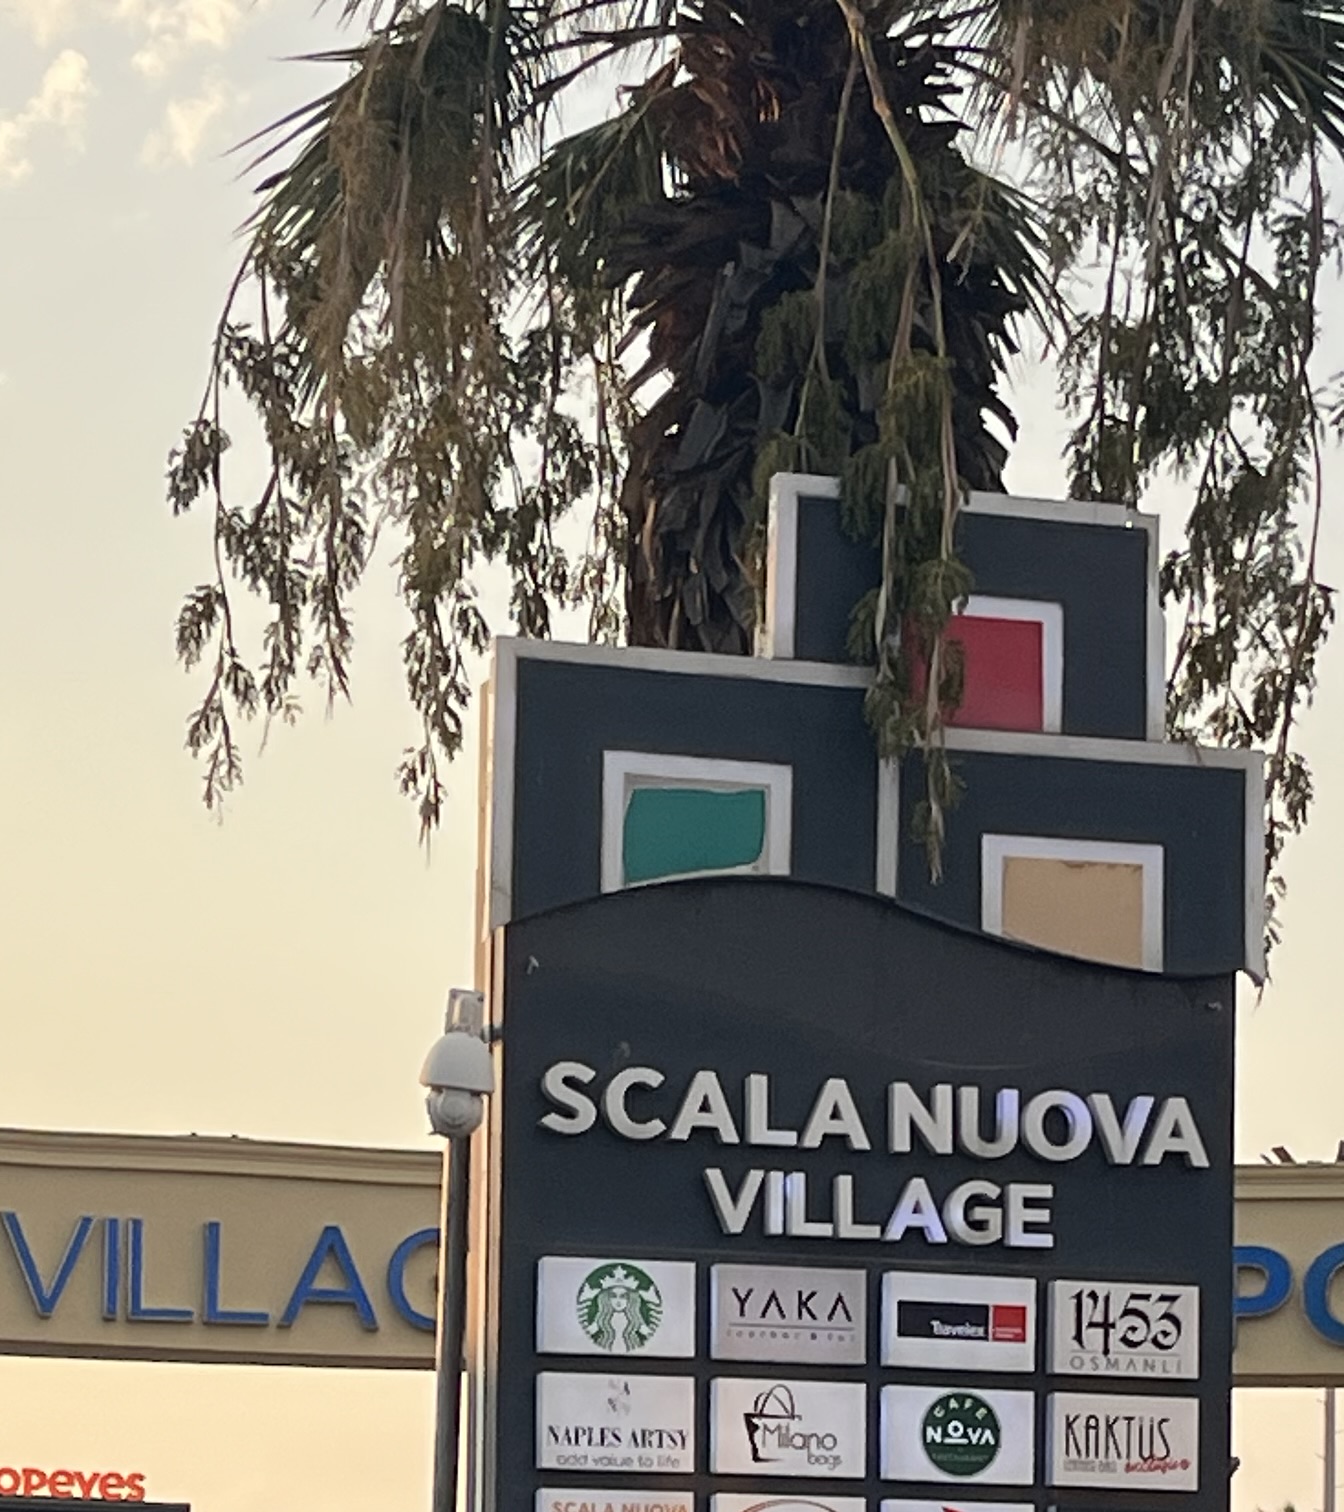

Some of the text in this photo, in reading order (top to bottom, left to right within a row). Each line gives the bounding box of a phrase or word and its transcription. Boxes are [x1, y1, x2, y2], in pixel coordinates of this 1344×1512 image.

[538, 1061, 1210, 1168] SCALA NUOVA
[703, 1167, 1054, 1248] VILLAGE
[1068, 1288, 1183, 1357] 1453
[933, 1397, 988, 1420] CAFE
[547, 1425, 689, 1450] NAPLES ARTSY
[761, 1422, 838, 1451] Milano
[925, 1420, 996, 1445] NOVA
